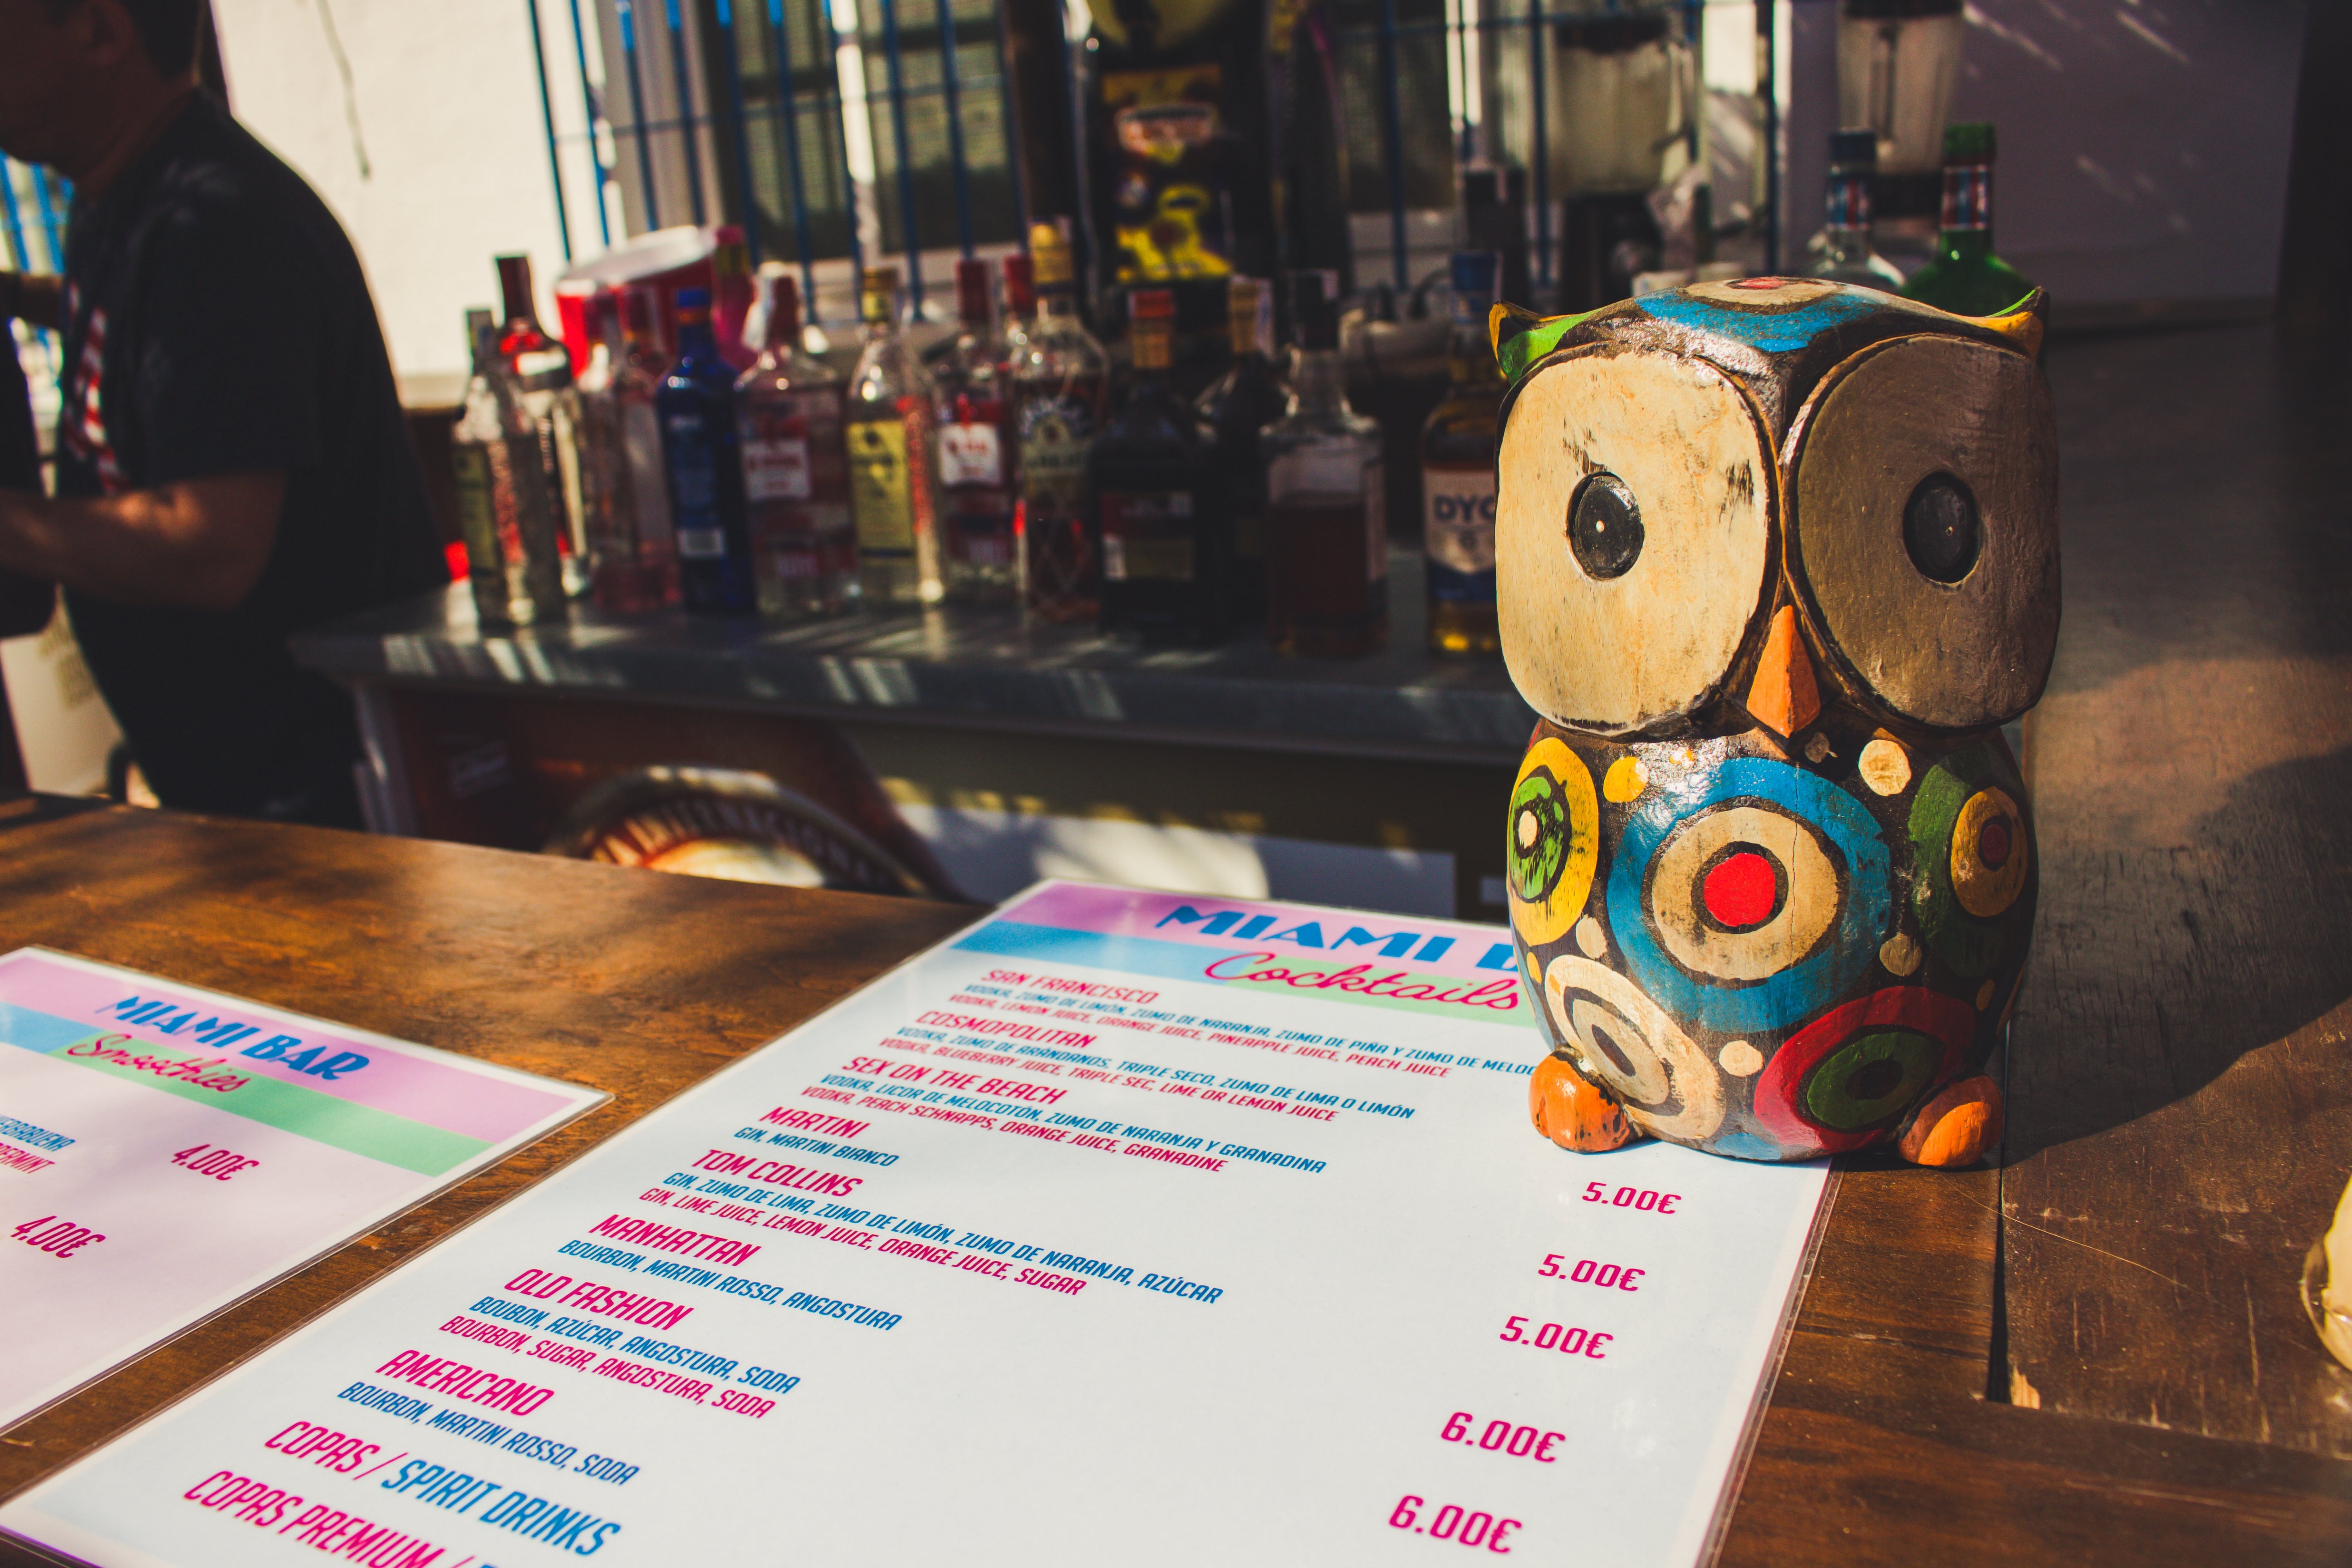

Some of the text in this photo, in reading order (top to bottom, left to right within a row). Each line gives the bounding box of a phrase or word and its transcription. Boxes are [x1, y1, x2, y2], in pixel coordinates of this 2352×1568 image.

[1155, 905, 1457, 963] MIAMI
[981, 969, 1159, 1004] SAN FRANCISCO
[1203, 951, 1519, 1010] Cocktails
[95, 995, 370, 1081] MIAMI BAR
[915, 1010, 1098, 1049] COSMOPOLITAN
[67, 1034, 253, 1093] Smoothies
[841, 1056, 1068, 1105] SEX ON THE BEACH
[733, 1126, 900, 1167] GIN, MARTINI BIANCO
[758, 1106, 871, 1139] MARTINI
[800, 1085, 1229, 1172] VODKA, PEACH SCHNAPPS, ORANGE JUICE, GRANADINE
[820, 1073, 1327, 1174] VODKA, LICOR DE MELOCOTÓN, ZUMO DE NARANJA Y GRANADINA
[170, 1143, 260, 1181] 4.00€
[691, 1148, 864, 1197] TOM COLLINS
[1581, 1181, 1682, 1215] 5.00€
[10, 1215, 107, 1259] 4.00€
[587, 1213, 762, 1267] MANHATTAN
[638, 1187, 1087, 1296] GIN, LIME JUICE, LEMON JUICE, ORANGE JUICE, SUGAR
[662, 1171, 1224, 1304] GIN, ZUMO DE LIMA, ZUMO DE LIMÓN, ZUMO DE NARANJA, AZÚCAR
[503, 1268, 695, 1331] OLD FASHION
[556, 1239, 903, 1331] BOURBON, MARTINI ROSSO, ANGOSTURA
[1537, 1253, 1646, 1292] 5.00€
[468, 1295, 801, 1395] BOUBON, AZÚCAR, ANGOSTURA, SODA
[1499, 1315, 1614, 1359] 5.00€
[374, 1349, 555, 1416] AMERICANO
[438, 1315, 776, 1419] BOURBON, SUGAR, ANGOSTURA, SODA
[336, 1381, 640, 1486] BOURBON, MARTINI ROSSO, SODA
[1440, 1411, 1566, 1463] 6.00€
[264, 1420, 381, 1474] COPAS
[380, 1459, 502, 1514] SPIRIT
[480, 1490, 621, 1557] DRINKS
[183, 1470, 446, 1568] COPAS PREMIUM
[1388, 1494, 1523, 1555] 6.00€
